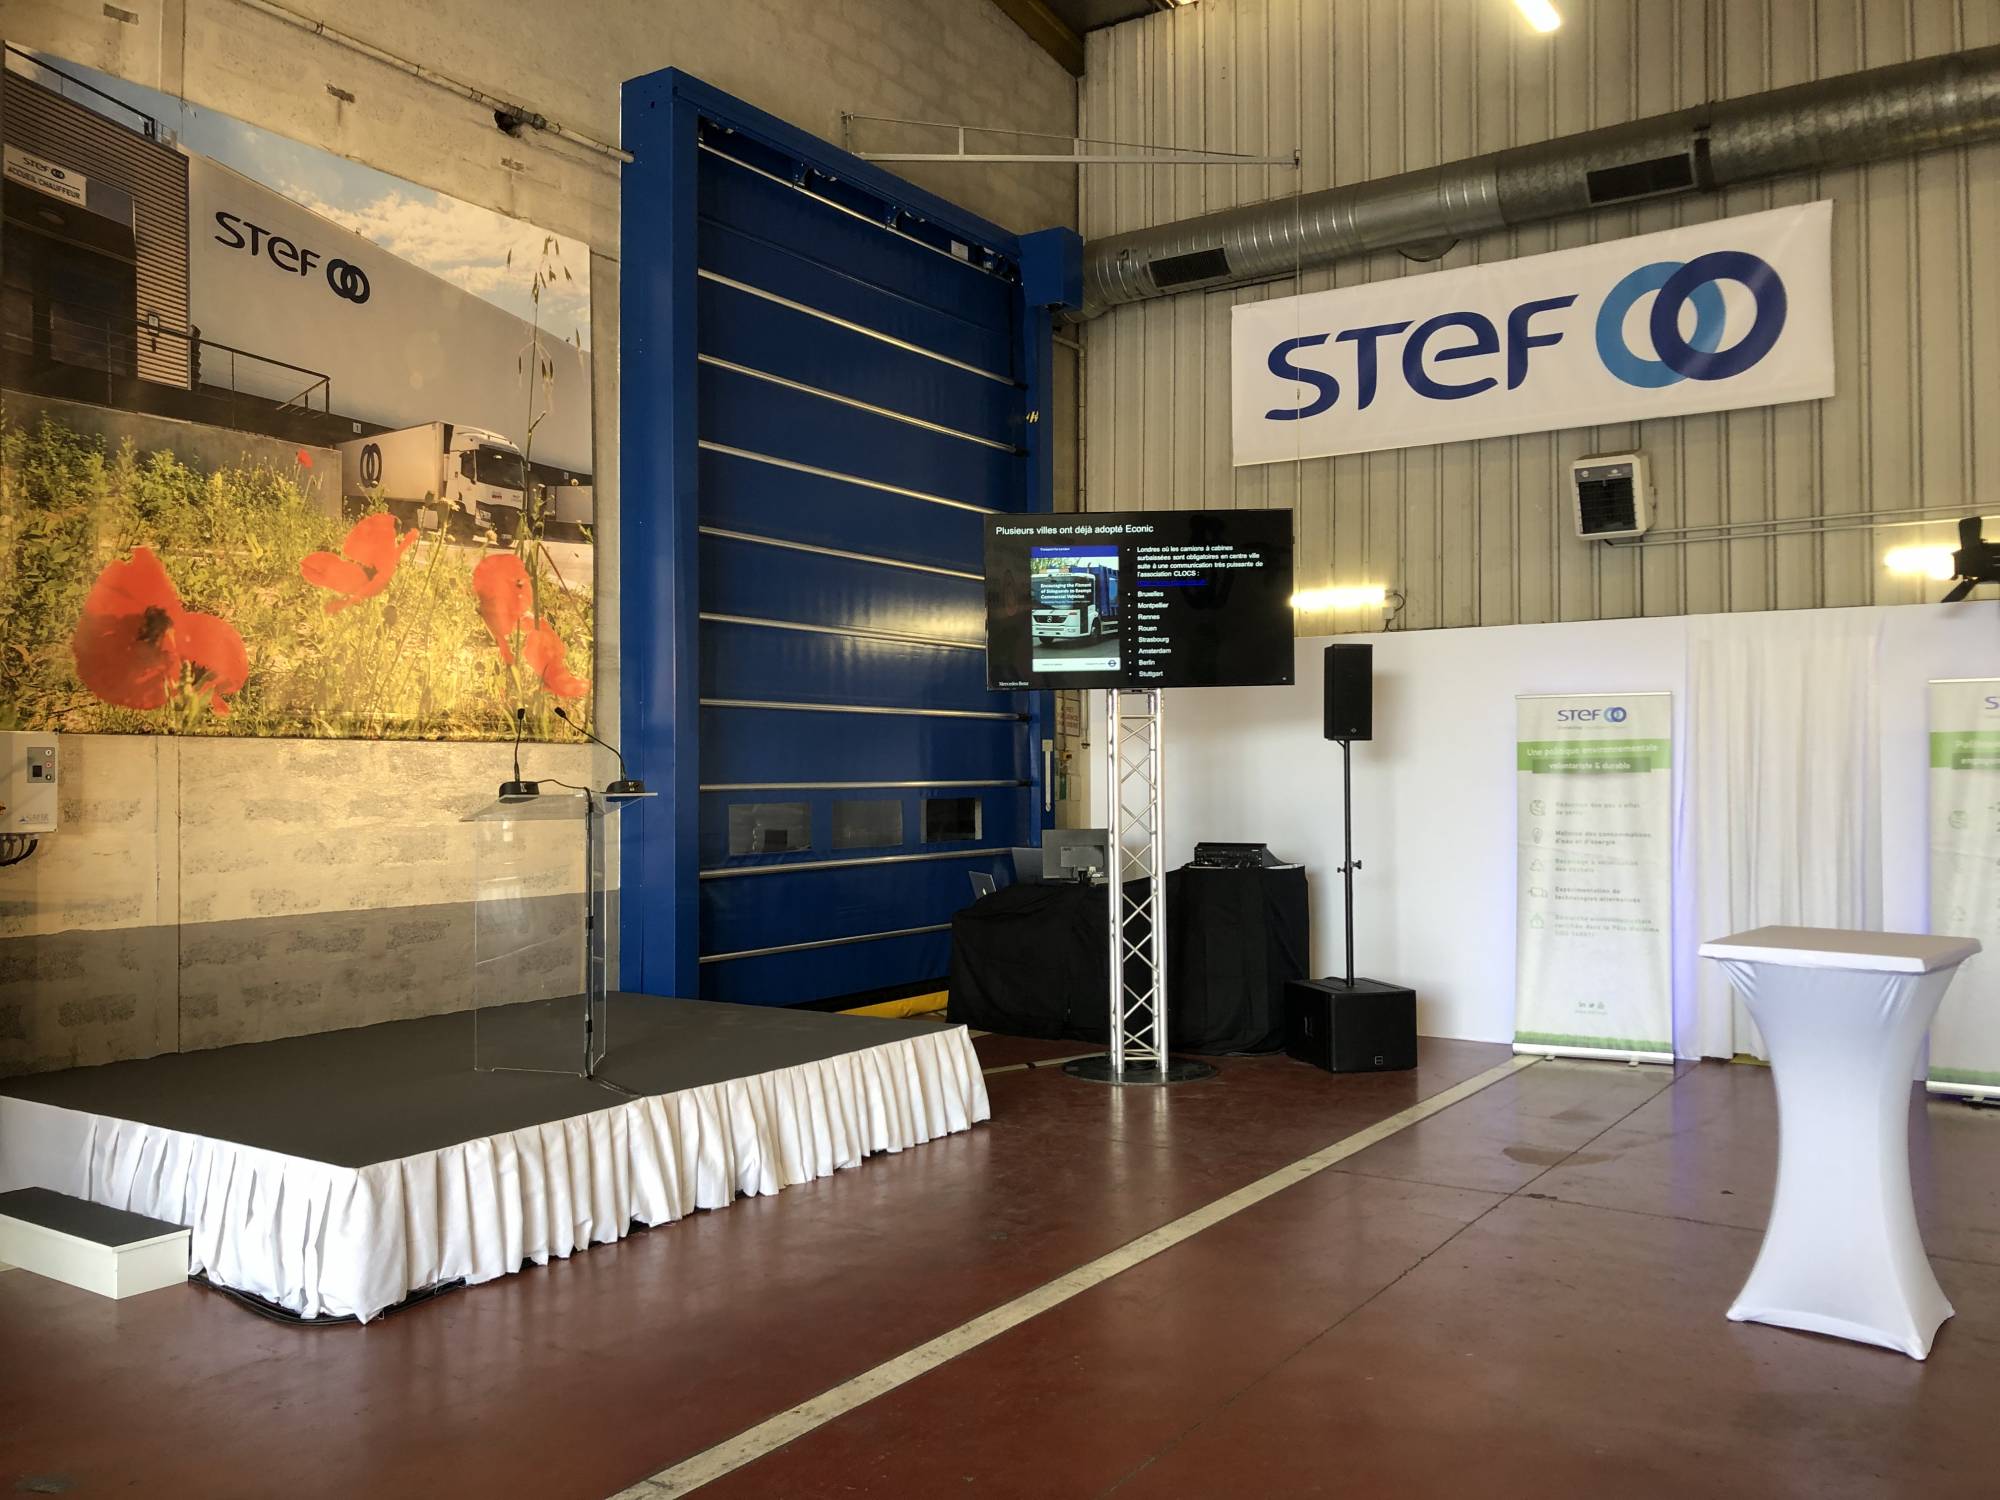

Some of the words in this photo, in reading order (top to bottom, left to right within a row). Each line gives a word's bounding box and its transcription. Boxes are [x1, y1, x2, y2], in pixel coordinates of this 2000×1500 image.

[996, 526, 1034, 535] Plusieurs
[1036, 526, 1058, 534] villes
[1060, 526, 1073, 534] ont
[1075, 525, 1092, 536] déjà
[1094, 525, 1123, 535] adopté
[1126, 525, 1154, 533] Econic
